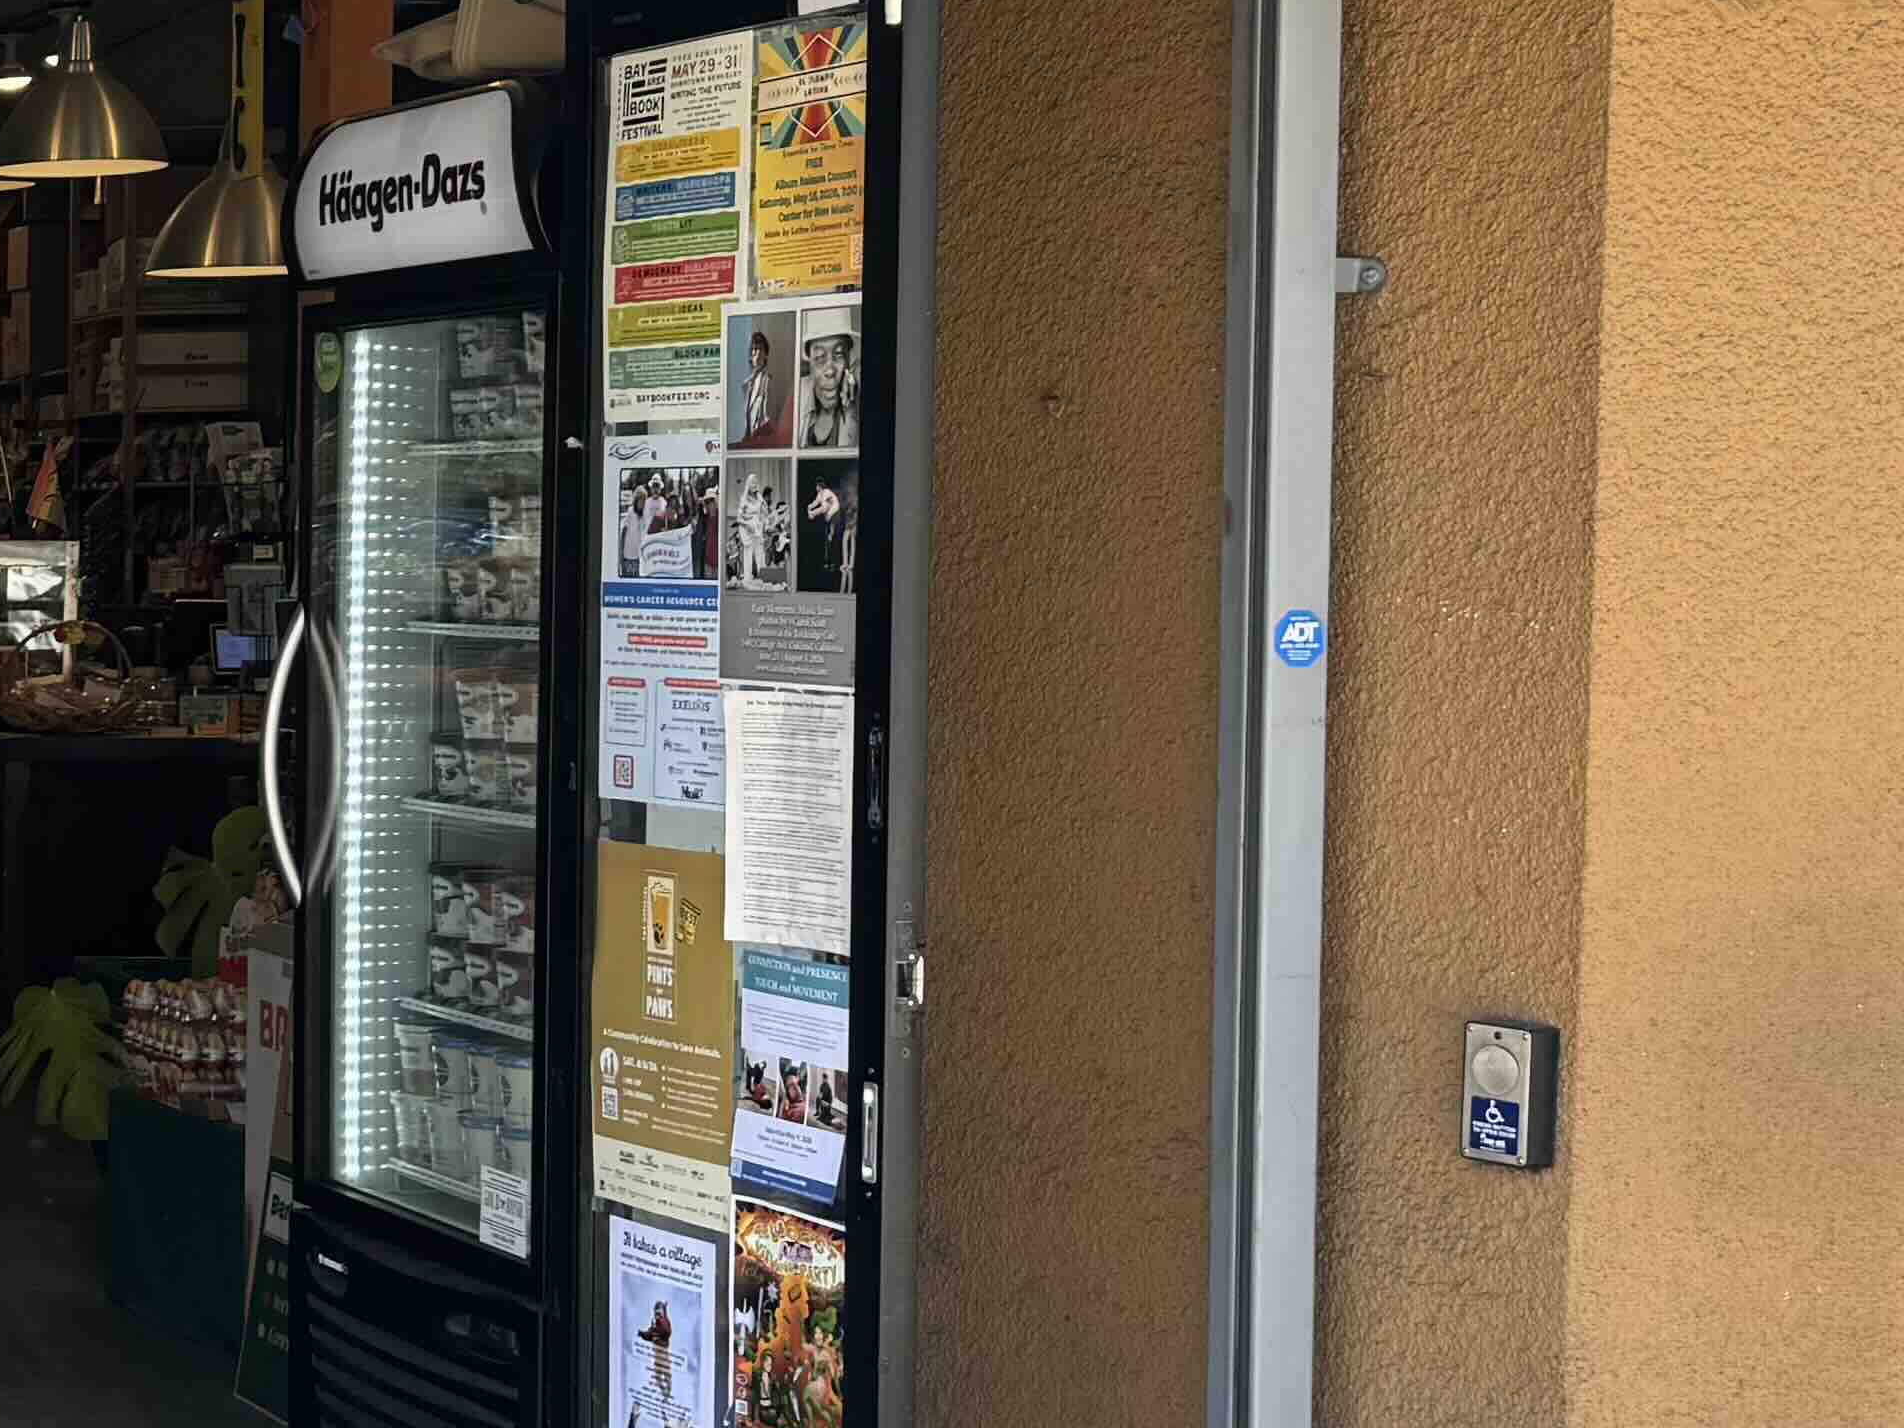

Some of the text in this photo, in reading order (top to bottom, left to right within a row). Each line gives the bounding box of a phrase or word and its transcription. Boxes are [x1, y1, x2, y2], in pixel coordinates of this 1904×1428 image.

[624, 62, 648, 80] BAY
[672, 61, 697, 77] MAY
[698, 85, 712, 94] THE
[714, 80, 742, 92] FUTURE
[629, 96, 661, 116] BOOK
[622, 123, 663, 140] FESTIVAL
[319, 152, 486, 233] Häagen-Dazs
[635, 595, 664, 605] CAREER
[1281, 621, 1320, 642] ADT
[647, 963, 673, 987] PINTS
[747, 955, 792, 972] CONNECTION
[805, 963, 849, 983] PRESENCE
[753, 976, 779, 990] TOUCH
[791, 983, 840, 1004] MOVEMENT
[646, 995, 673, 1019] PAWS
[633, 1233, 658, 1255] takes
[658, 1245, 667, 1258] a
[668, 1244, 703, 1270] village
